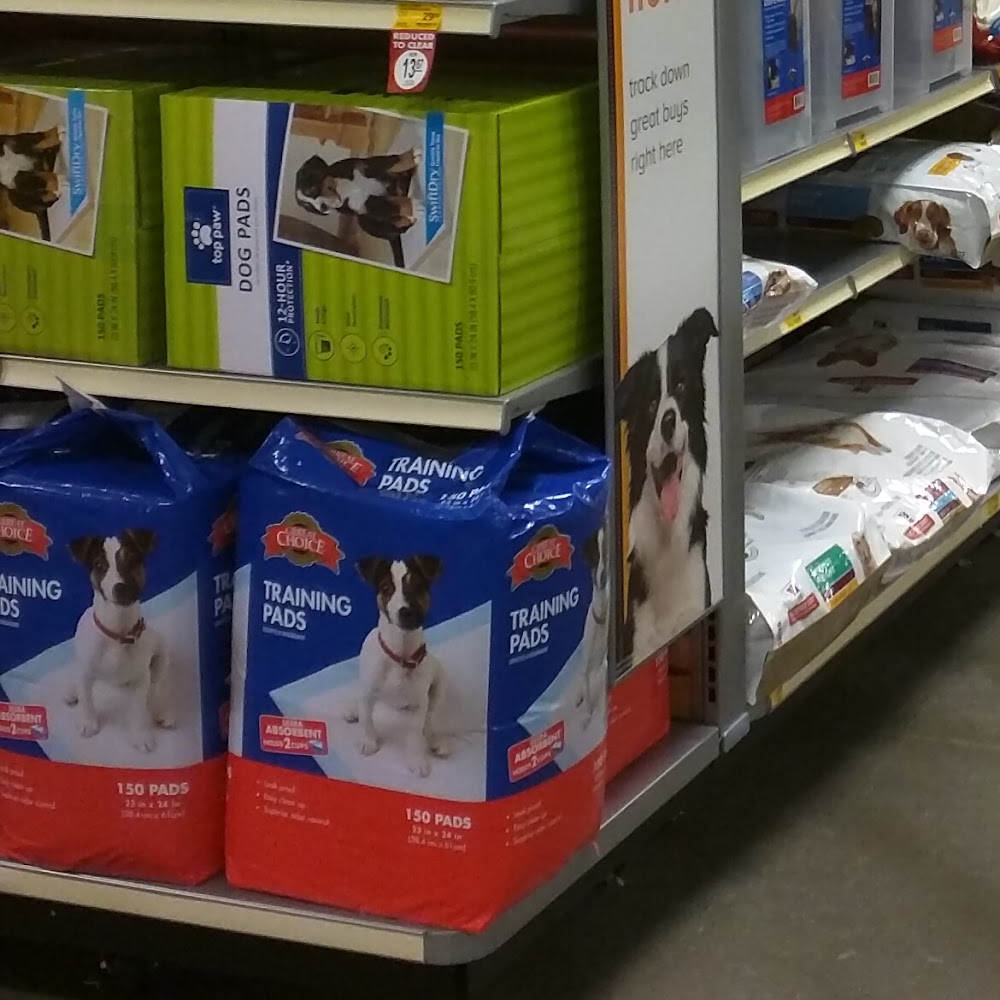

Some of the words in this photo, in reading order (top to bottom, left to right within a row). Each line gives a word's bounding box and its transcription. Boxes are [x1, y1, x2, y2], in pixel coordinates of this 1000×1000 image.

[393, 32, 435, 40] REDUCED
[629, 71, 658, 98] track
[660, 61, 690, 89] down
[630, 107, 660, 141] great
[662, 97, 689, 126] buys
[630, 144, 657, 177] right
[659, 136, 684, 164] here
[428, 168, 441, 222] SwiftDry
[212, 210, 224, 239] paw
[236, 187, 251, 239] PADS
[212, 240, 224, 264] top
[238, 247, 253, 293] DOG
[275, 264, 288, 322] 12-HOUR
[455, 321, 463, 350] PADS
[378, 474, 431, 494] PADS
[388, 456, 485, 483] TRAINING
[276, 530, 325, 554] CHOICE
[524, 542, 562, 569] CHOICE
[263, 580, 352, 617] TRAINING
[510, 586, 580, 630] TRAINING
[262, 603, 307, 631] PADS
[509, 623, 549, 654] PADS
[265, 725, 322, 739] ABSORBENT
[283, 737, 291, 749] 2
[117, 782, 145, 795] 150
[149, 782, 190, 796] PADS
[405, 808, 431, 824] 150
[435, 813, 472, 830] PADS
